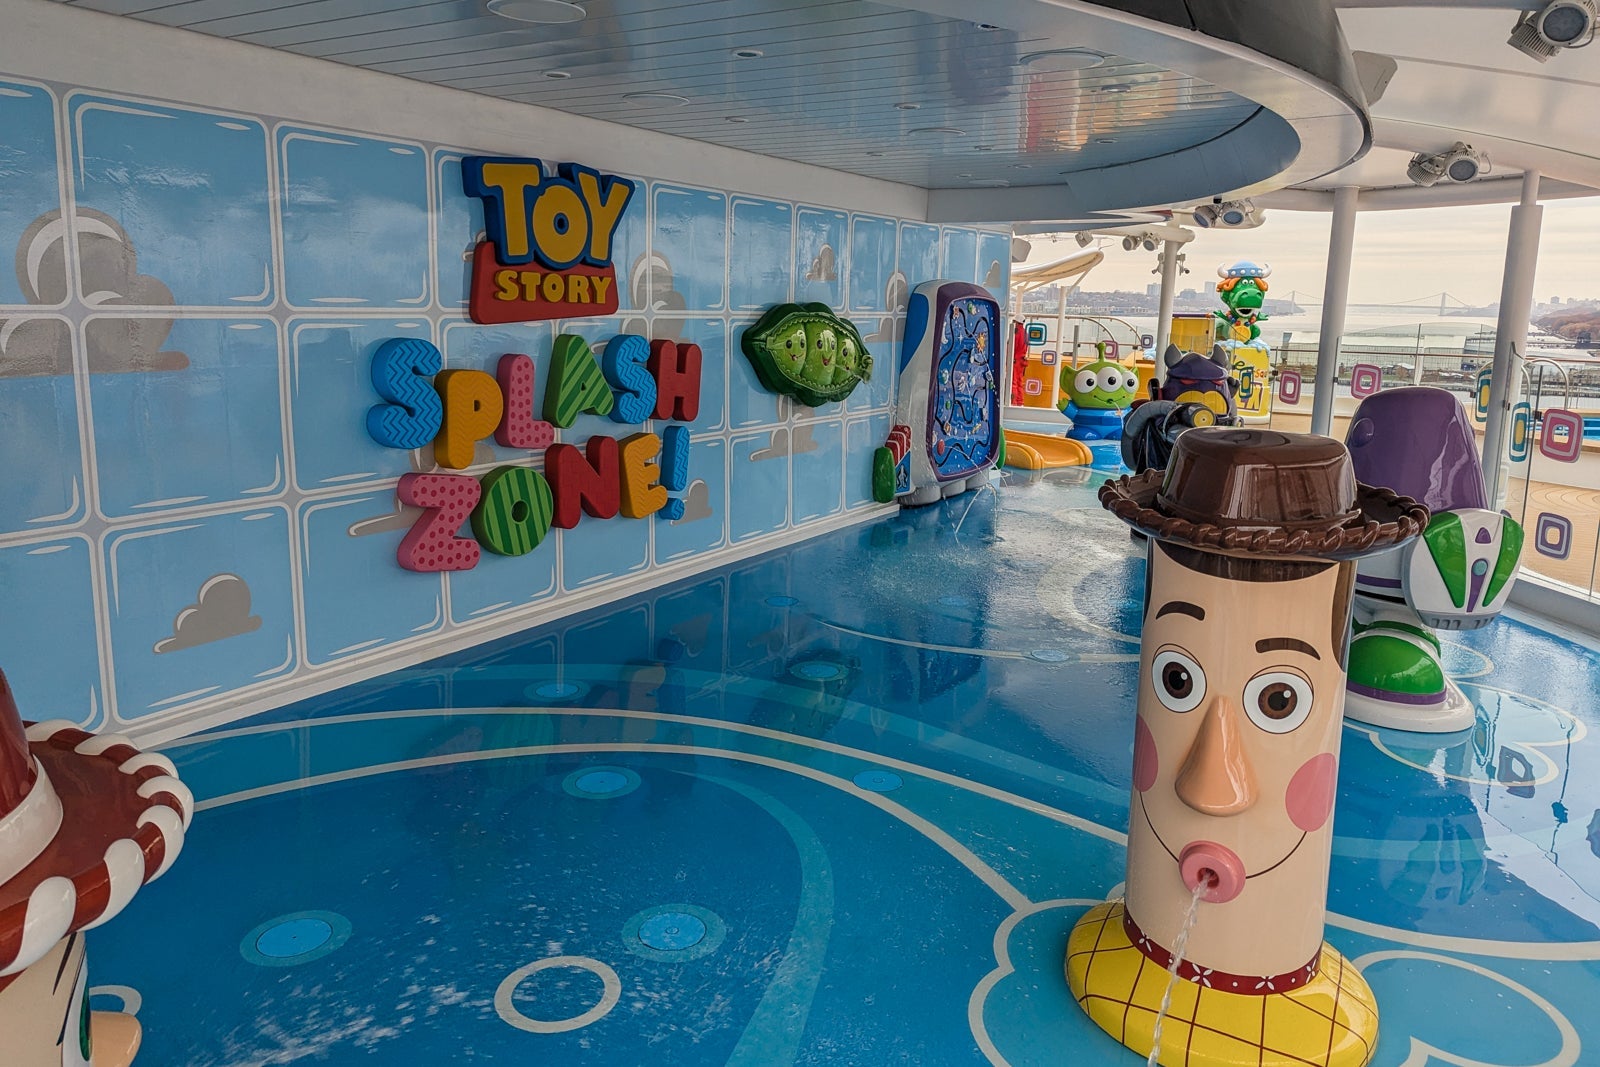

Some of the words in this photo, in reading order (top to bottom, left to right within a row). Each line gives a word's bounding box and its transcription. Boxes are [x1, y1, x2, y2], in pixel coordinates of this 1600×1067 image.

[470, 158, 635, 268] TOY
[494, 270, 612, 304] STORY
[366, 334, 702, 470] SPLASH
[397, 425, 690, 573] ZONE!
